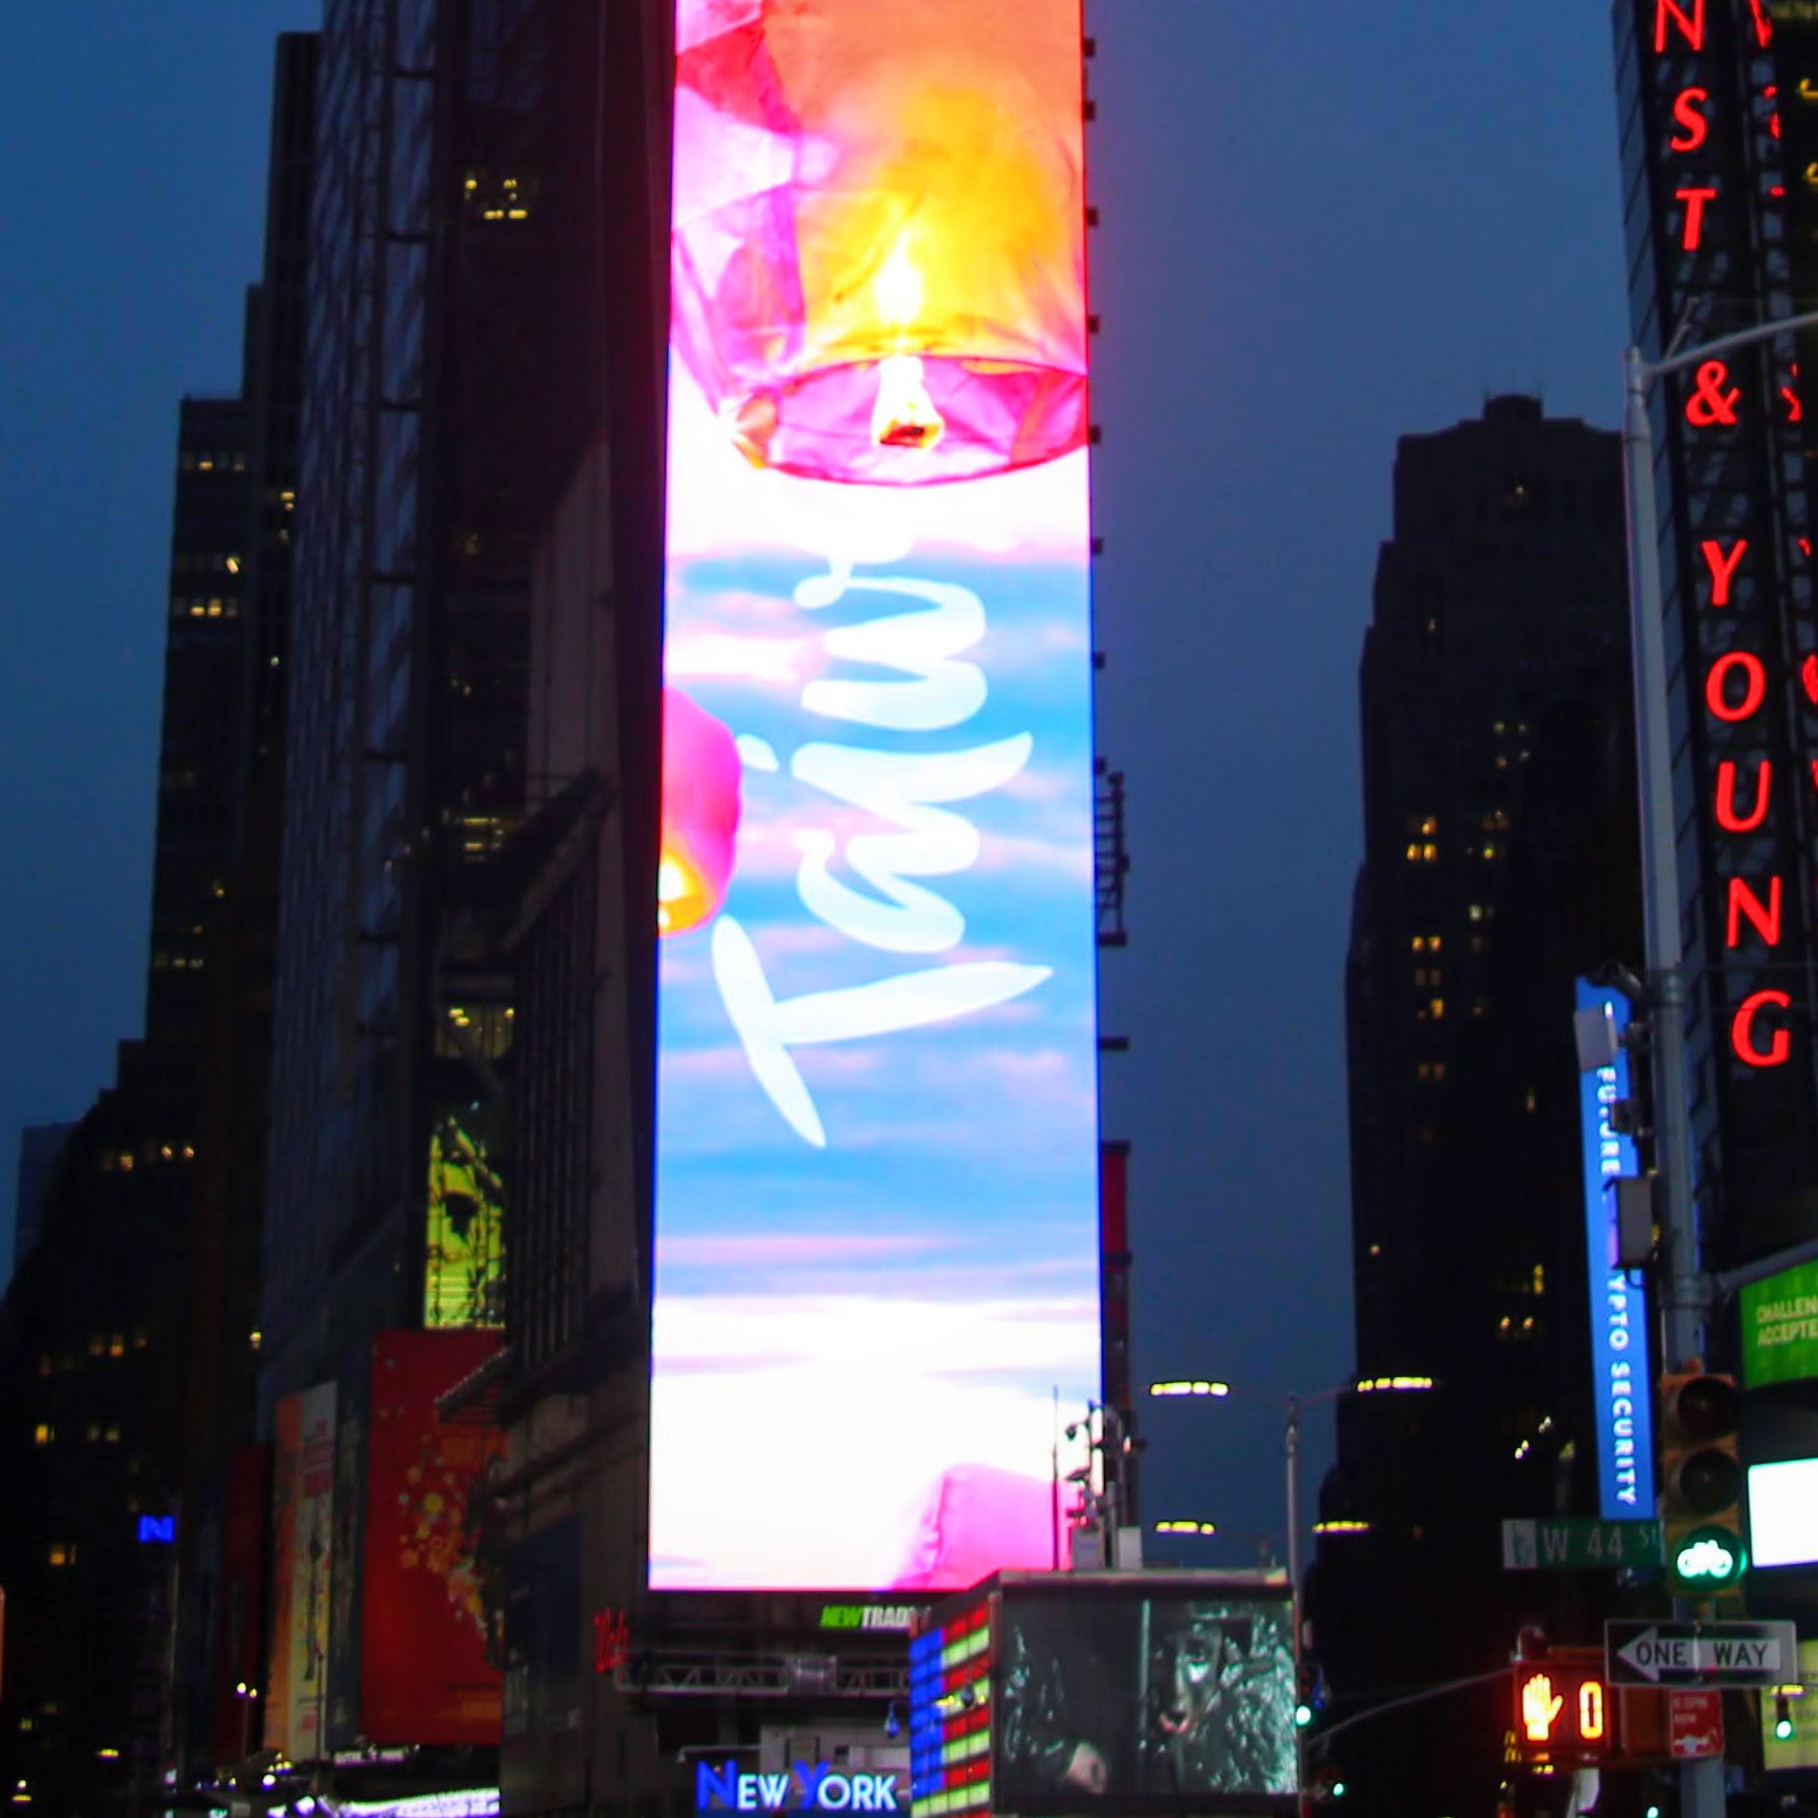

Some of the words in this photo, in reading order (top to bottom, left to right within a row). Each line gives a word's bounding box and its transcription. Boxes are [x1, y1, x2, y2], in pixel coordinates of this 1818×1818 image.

[1685, 359, 1741, 426] &
[1701, 539, 1791, 1068] YOUNG
[711, 534, 1053, 1149] Taiw
[1595, 1066, 1621, 1176] FUURE
[1610, 1360, 1638, 1508] SECURITY
[1542, 1526, 1570, 1563] W
[1585, 1525, 1624, 1563] 44
[1634, 1639, 1688, 1668] ONE
[1713, 1638, 1769, 1667] WAY
[1578, 1680, 1604, 1740] 0
[696, 1759, 789, 1811] NEW
[793, 1759, 898, 1811] YORK
